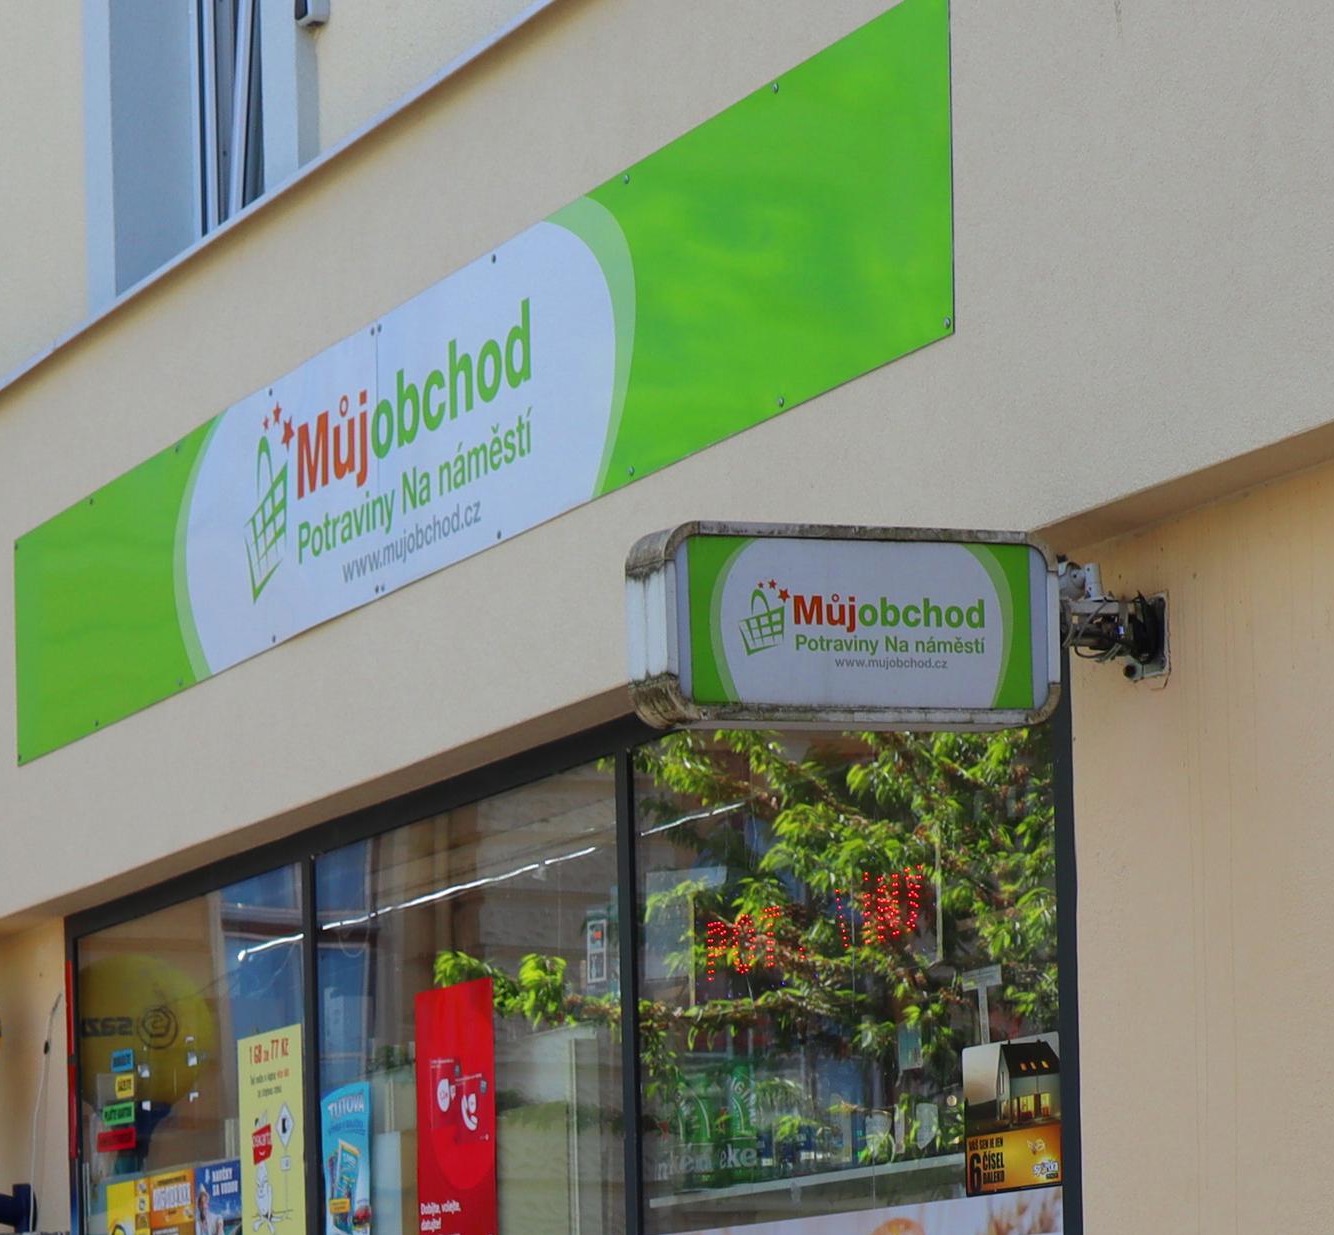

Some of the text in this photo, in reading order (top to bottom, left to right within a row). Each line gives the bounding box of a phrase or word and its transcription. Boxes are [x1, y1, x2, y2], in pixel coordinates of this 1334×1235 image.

[297, 297, 532, 499] Můjobchod
[298, 407, 533, 565] Potraviny Na náměstí
[342, 501, 481, 584] www.mujobchod.cz
[793, 593, 986, 633] Můjobchod
[795, 634, 986, 656] Potraviny Na náměstí
[835, 657, 948, 670] www.mujobchod.cz
[969, 1153, 981, 1193] 6
[982, 1150, 1004, 1171] ČÍSEL
